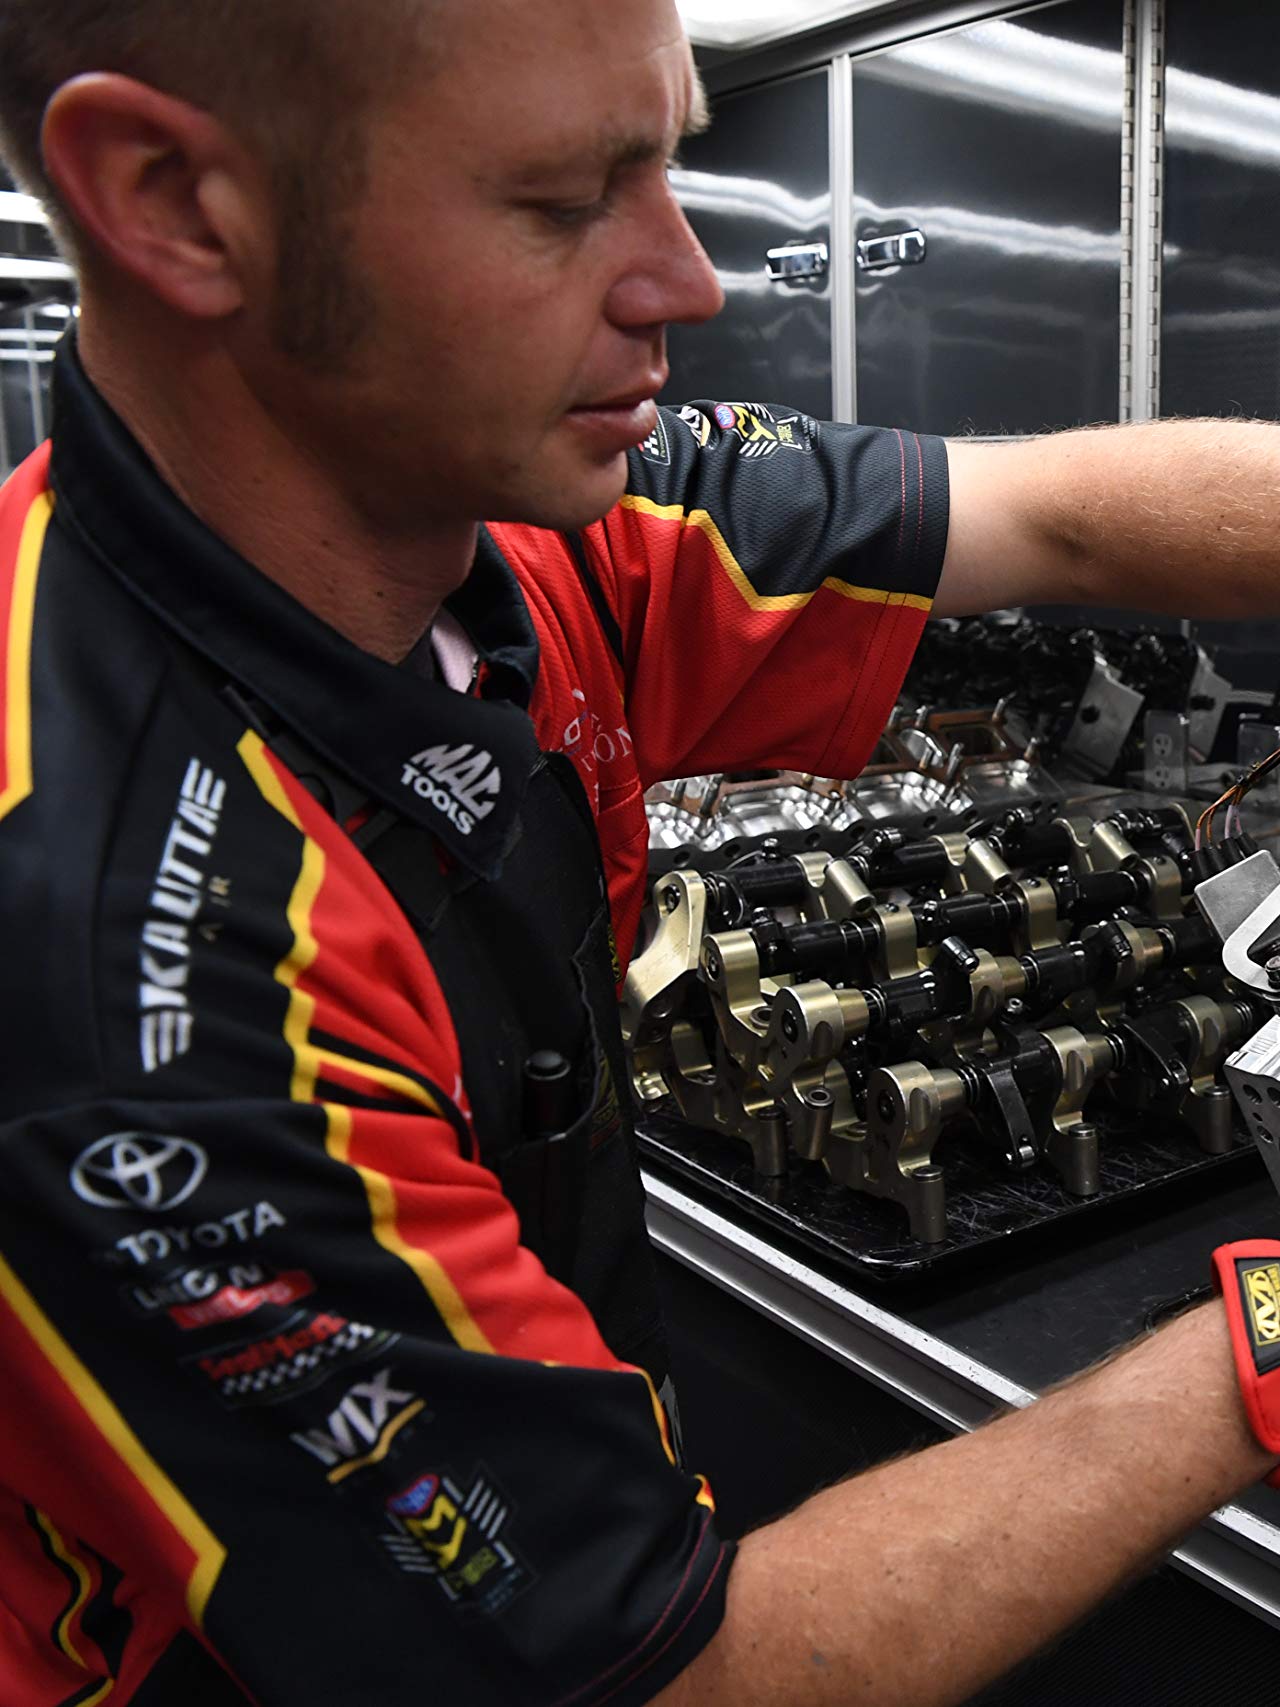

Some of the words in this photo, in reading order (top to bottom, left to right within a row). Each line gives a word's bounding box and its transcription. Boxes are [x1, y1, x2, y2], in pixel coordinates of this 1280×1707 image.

[400, 763, 475, 835] TOOLS
[410, 743, 501, 820] MAC
[116, 1200, 287, 1265] TOYOTA
[289, 1367, 415, 1466] WIX
